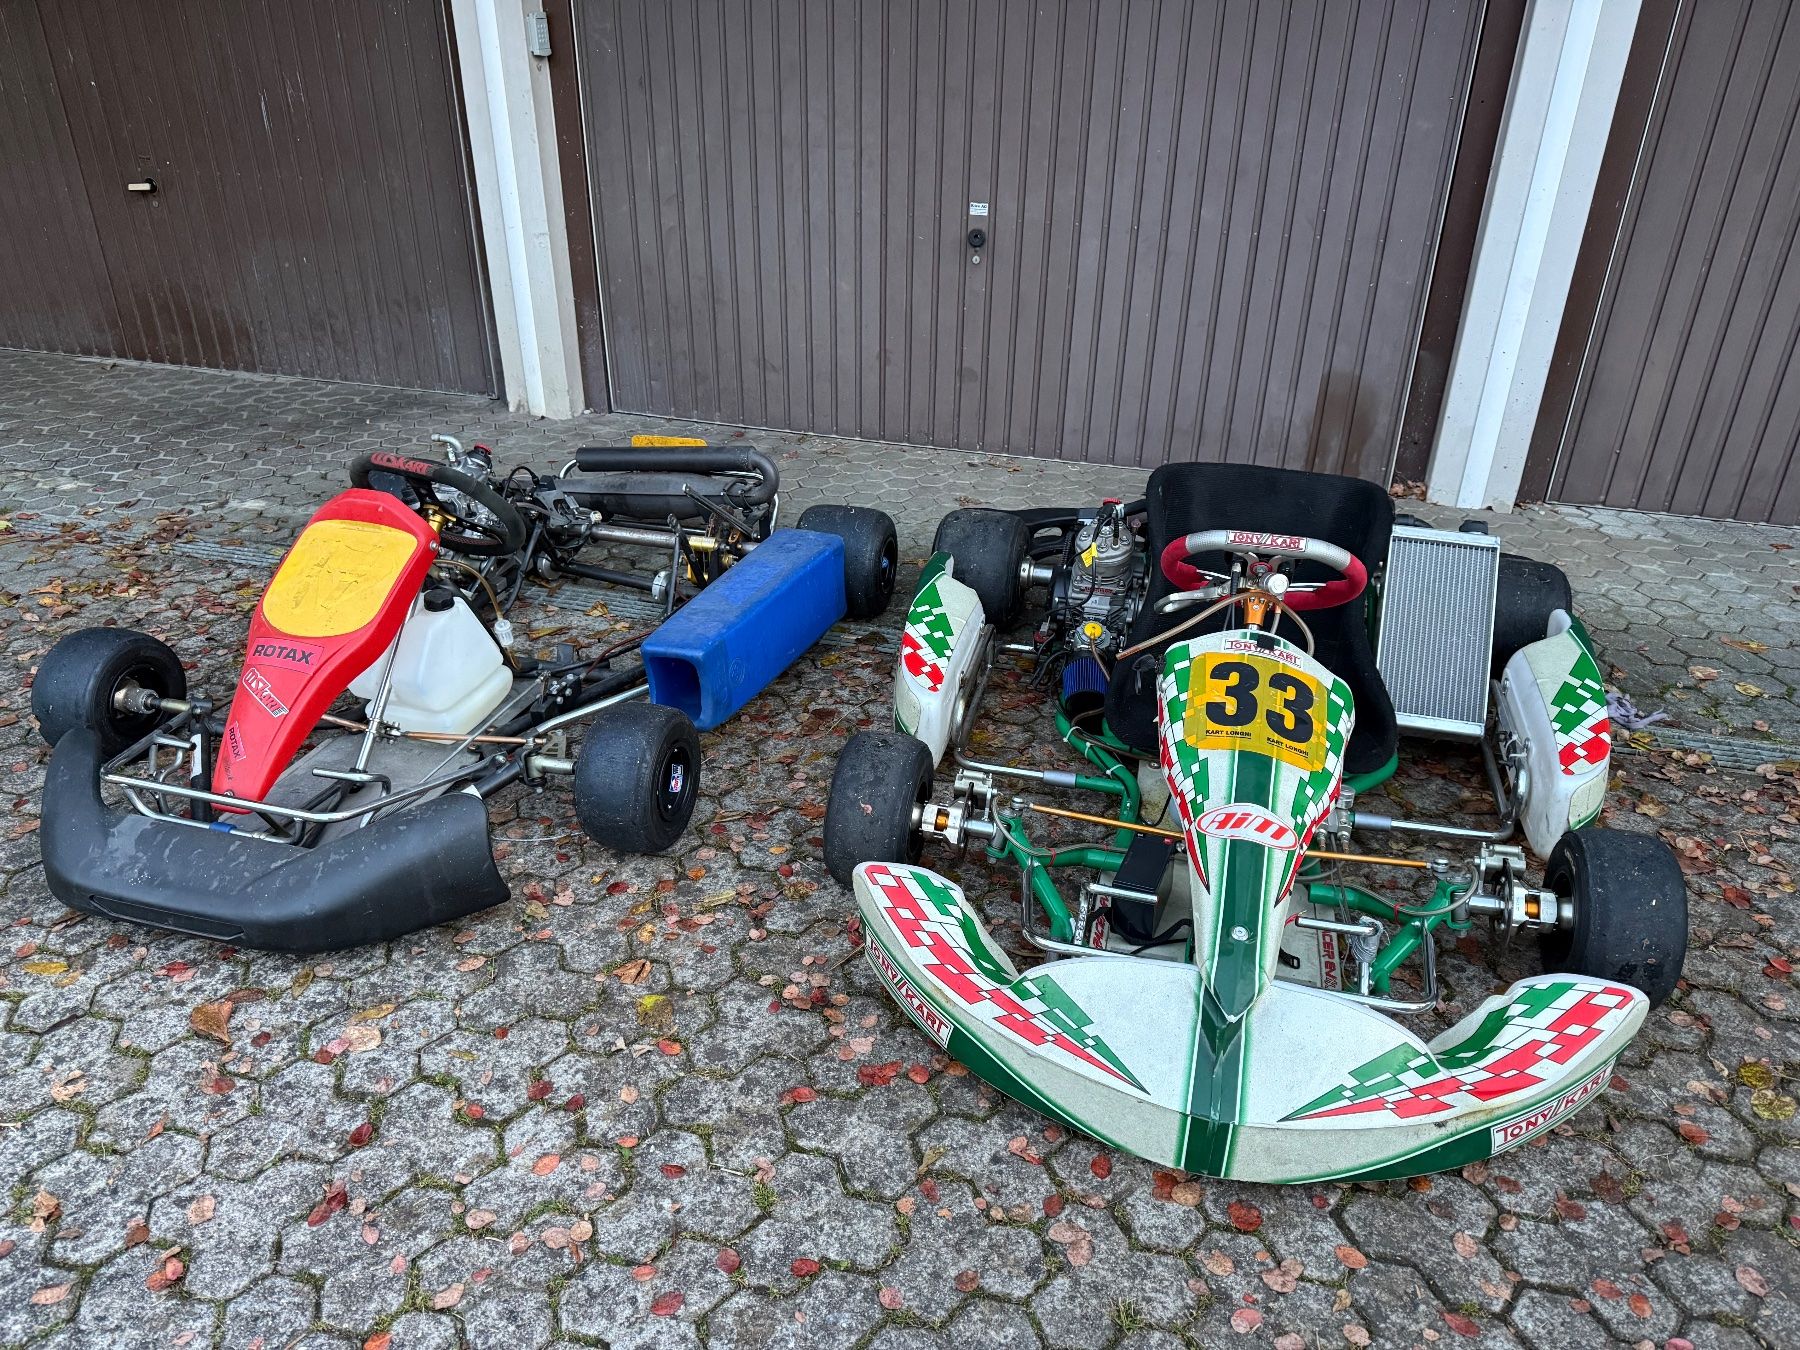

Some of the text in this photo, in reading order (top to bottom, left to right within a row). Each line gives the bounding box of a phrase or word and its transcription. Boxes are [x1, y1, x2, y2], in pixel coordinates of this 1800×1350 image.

[253, 644, 315, 665] ROTAX
[1205, 661, 1315, 744] 33
[228, 726, 241, 759] ROTAX
[1266, 736, 1309, 757] KART LONGHI
